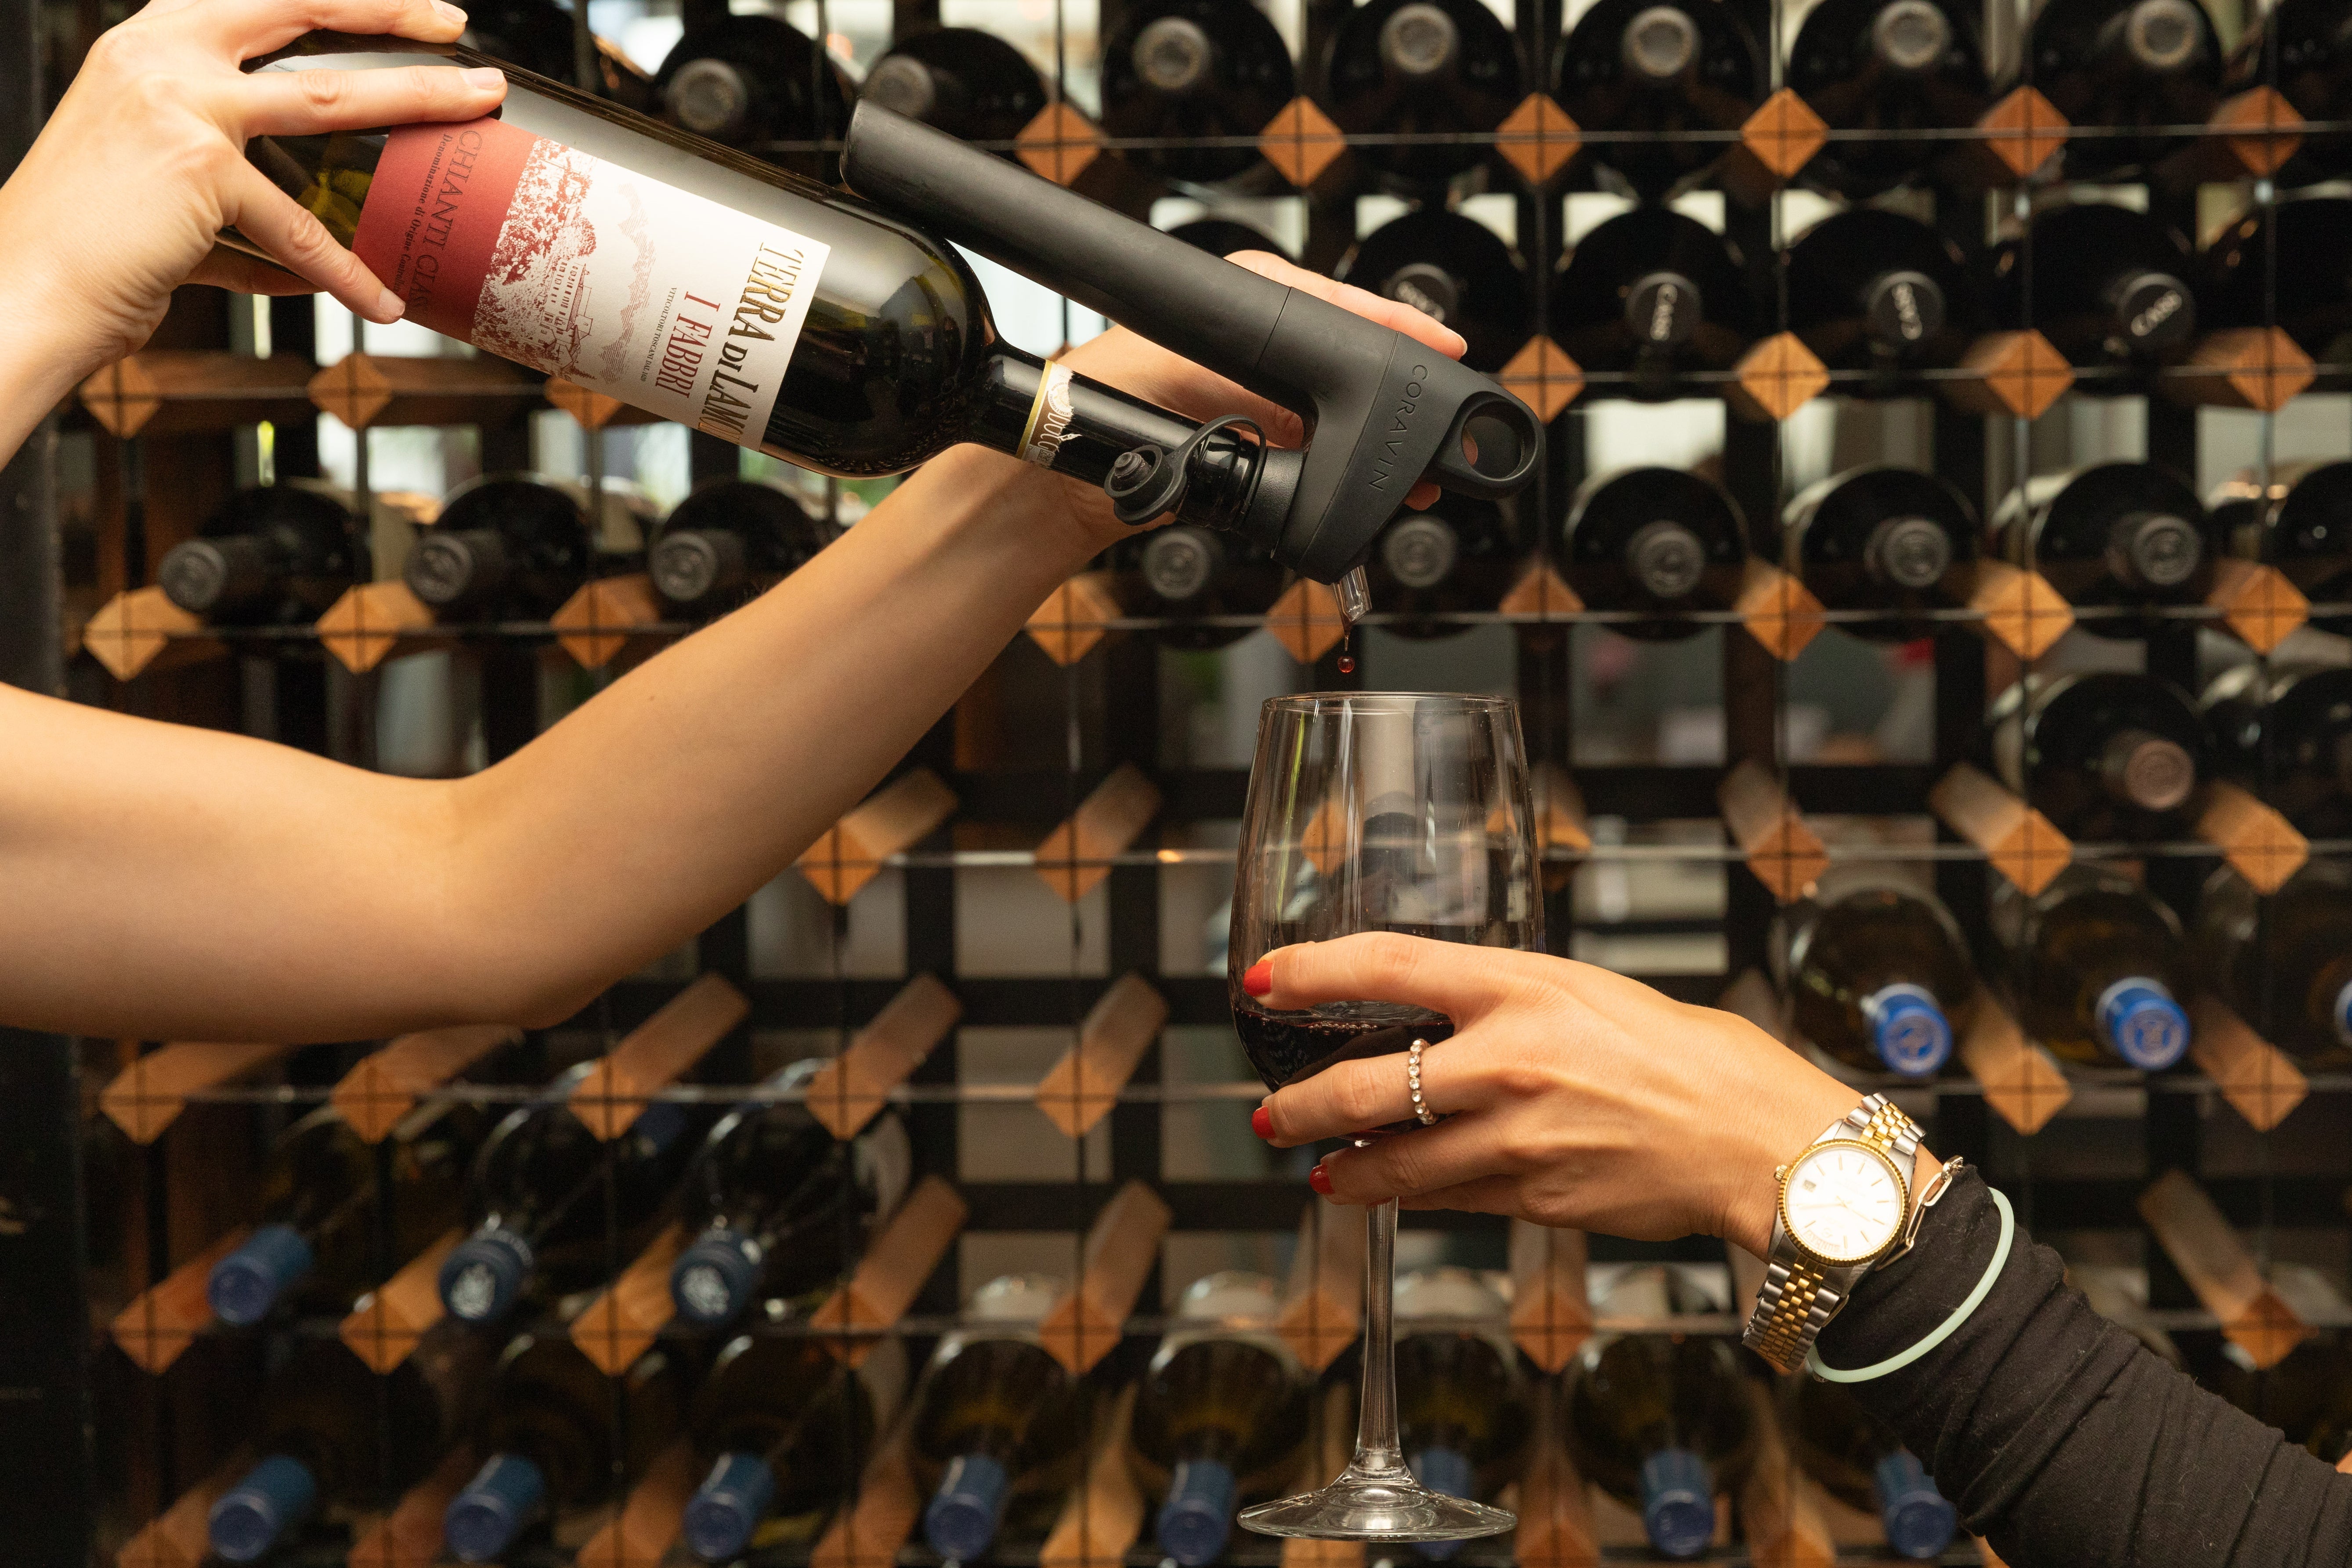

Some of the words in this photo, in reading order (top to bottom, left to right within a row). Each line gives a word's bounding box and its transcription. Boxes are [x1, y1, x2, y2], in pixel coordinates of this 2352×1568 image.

[419, 133, 453, 203] Denominazione
[423, 130, 483, 250] CHIANTI
[414, 206, 425, 217] di
[404, 219, 422, 251] Origine
[656, 288, 677, 332] VITICOLTORI
[684, 291, 720, 312] I
[728, 242, 804, 341] TERRA
[643, 359, 652, 371] DAL
[647, 332, 661, 360] TOSCANI
[655, 313, 713, 398] FABBRI
[718, 341, 748, 372] DI
[1368, 365, 1429, 491] CORAVIN
